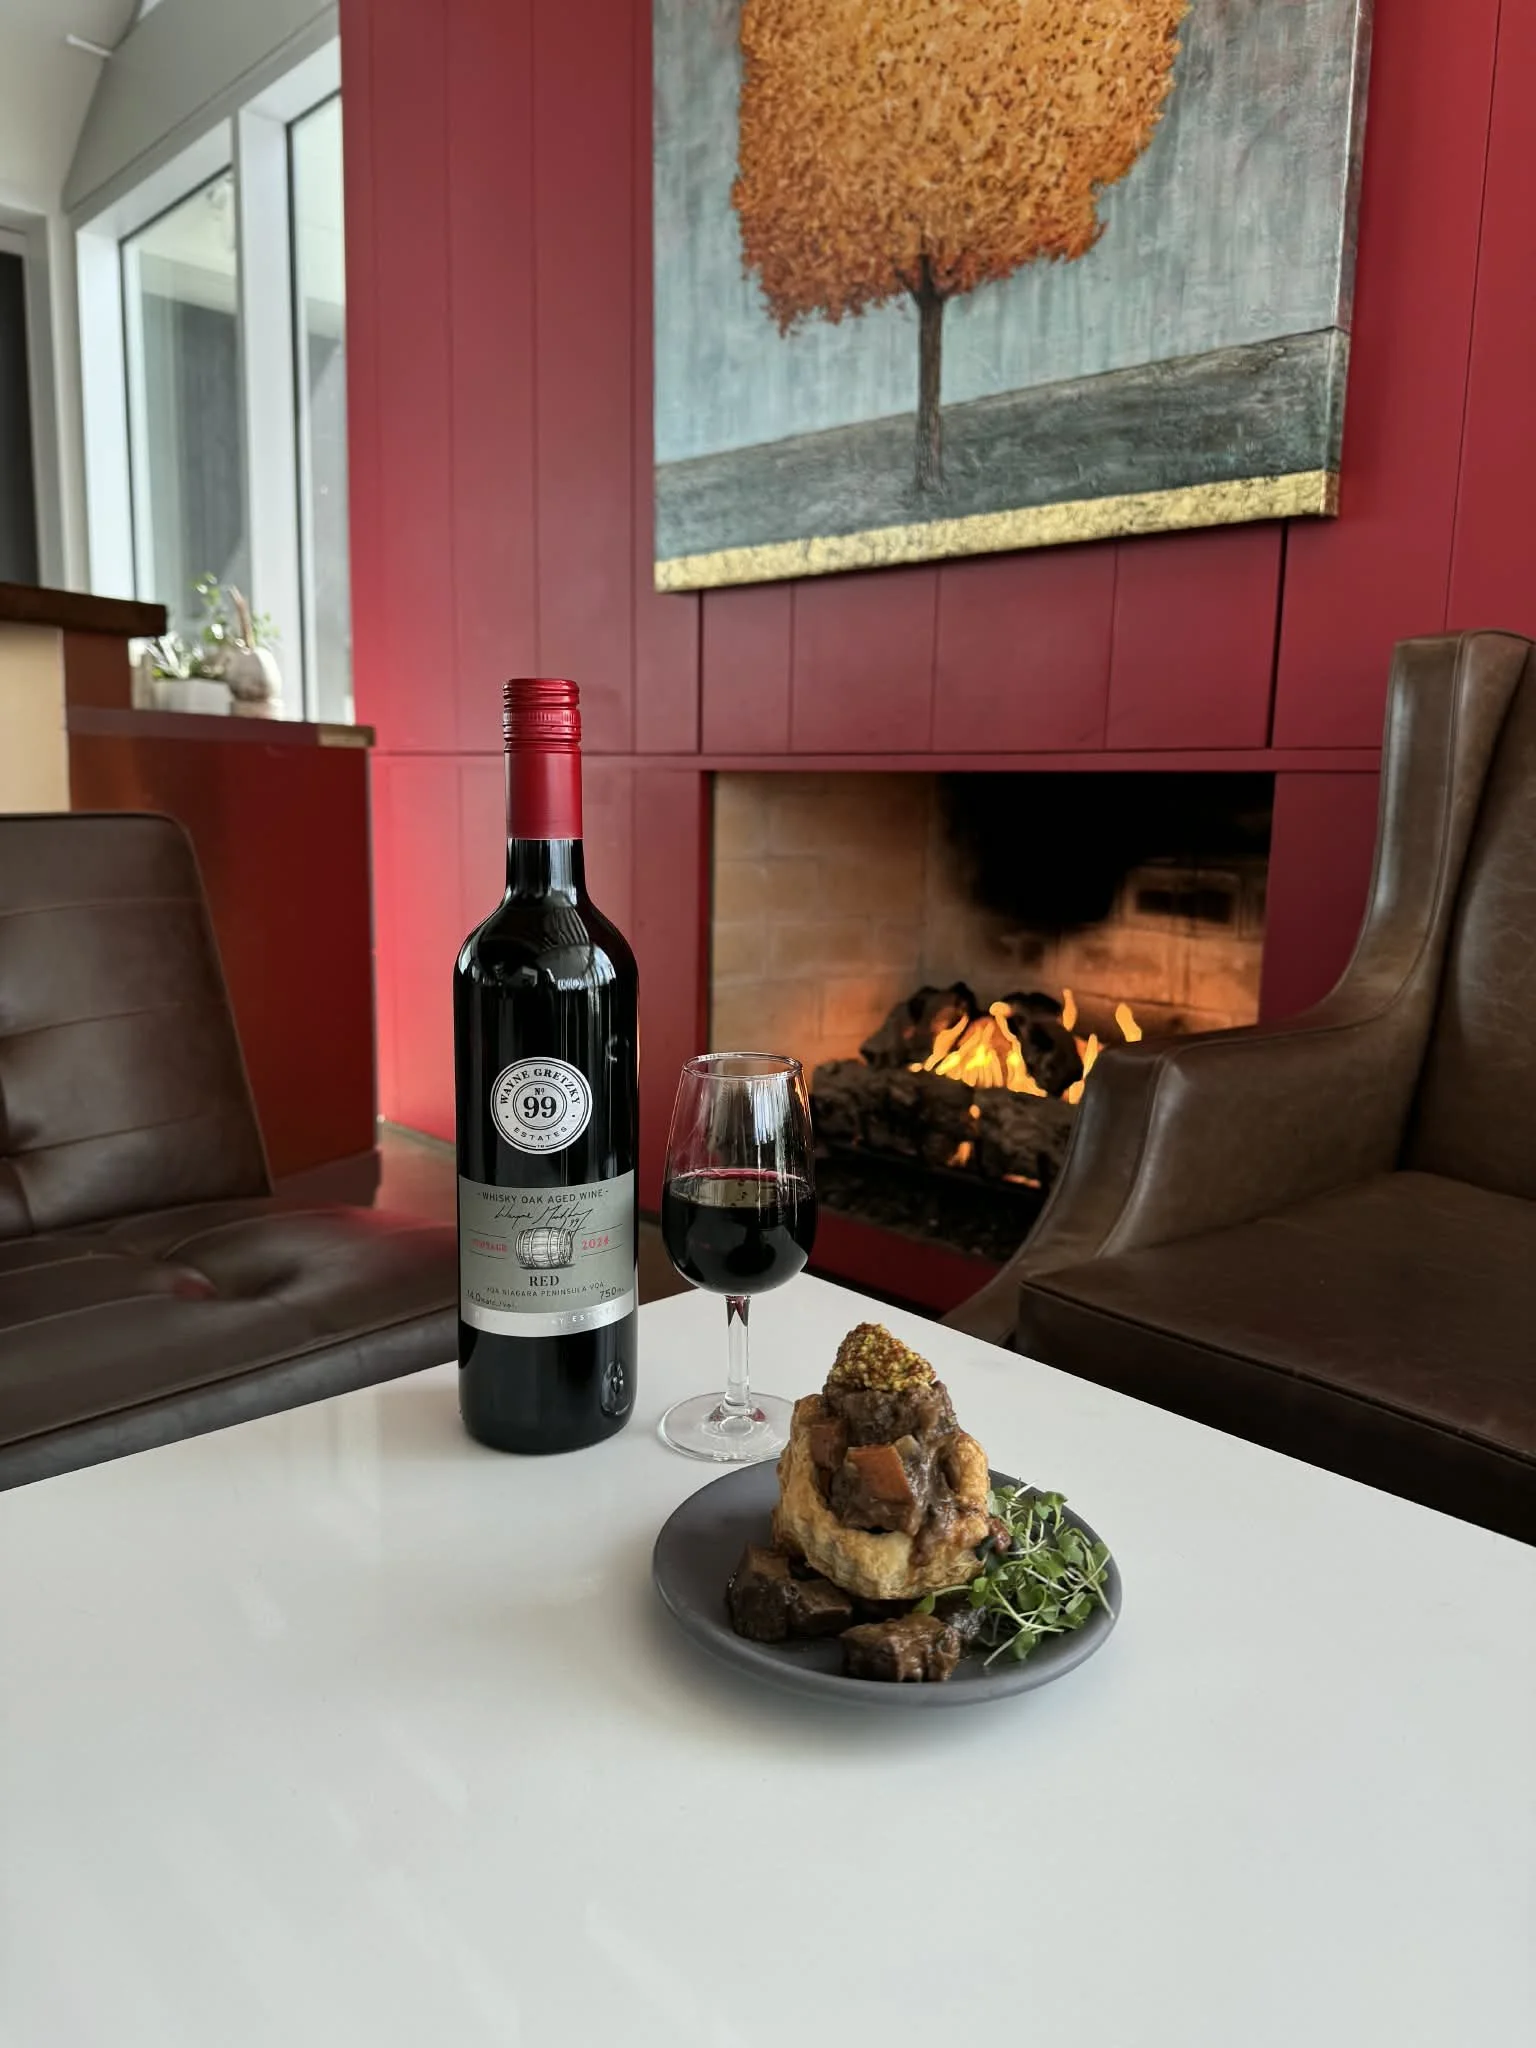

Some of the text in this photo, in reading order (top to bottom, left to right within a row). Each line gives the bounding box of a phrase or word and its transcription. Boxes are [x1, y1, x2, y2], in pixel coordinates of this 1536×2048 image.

[500, 1068, 581, 1104] WAYNE GRETZKY
[523, 1096, 557, 1118] 99
[513, 1126, 568, 1141] ESTATES
[482, 1188, 603, 1204] WHISKY OAK AGED WINE
[581, 1234, 609, 1251] 2024
[502, 1288, 538, 1298] NIAGARA
[540, 1284, 588, 1297] PENINSULA
[589, 1280, 604, 1291] VQA
[529, 1275, 560, 1287] RED
